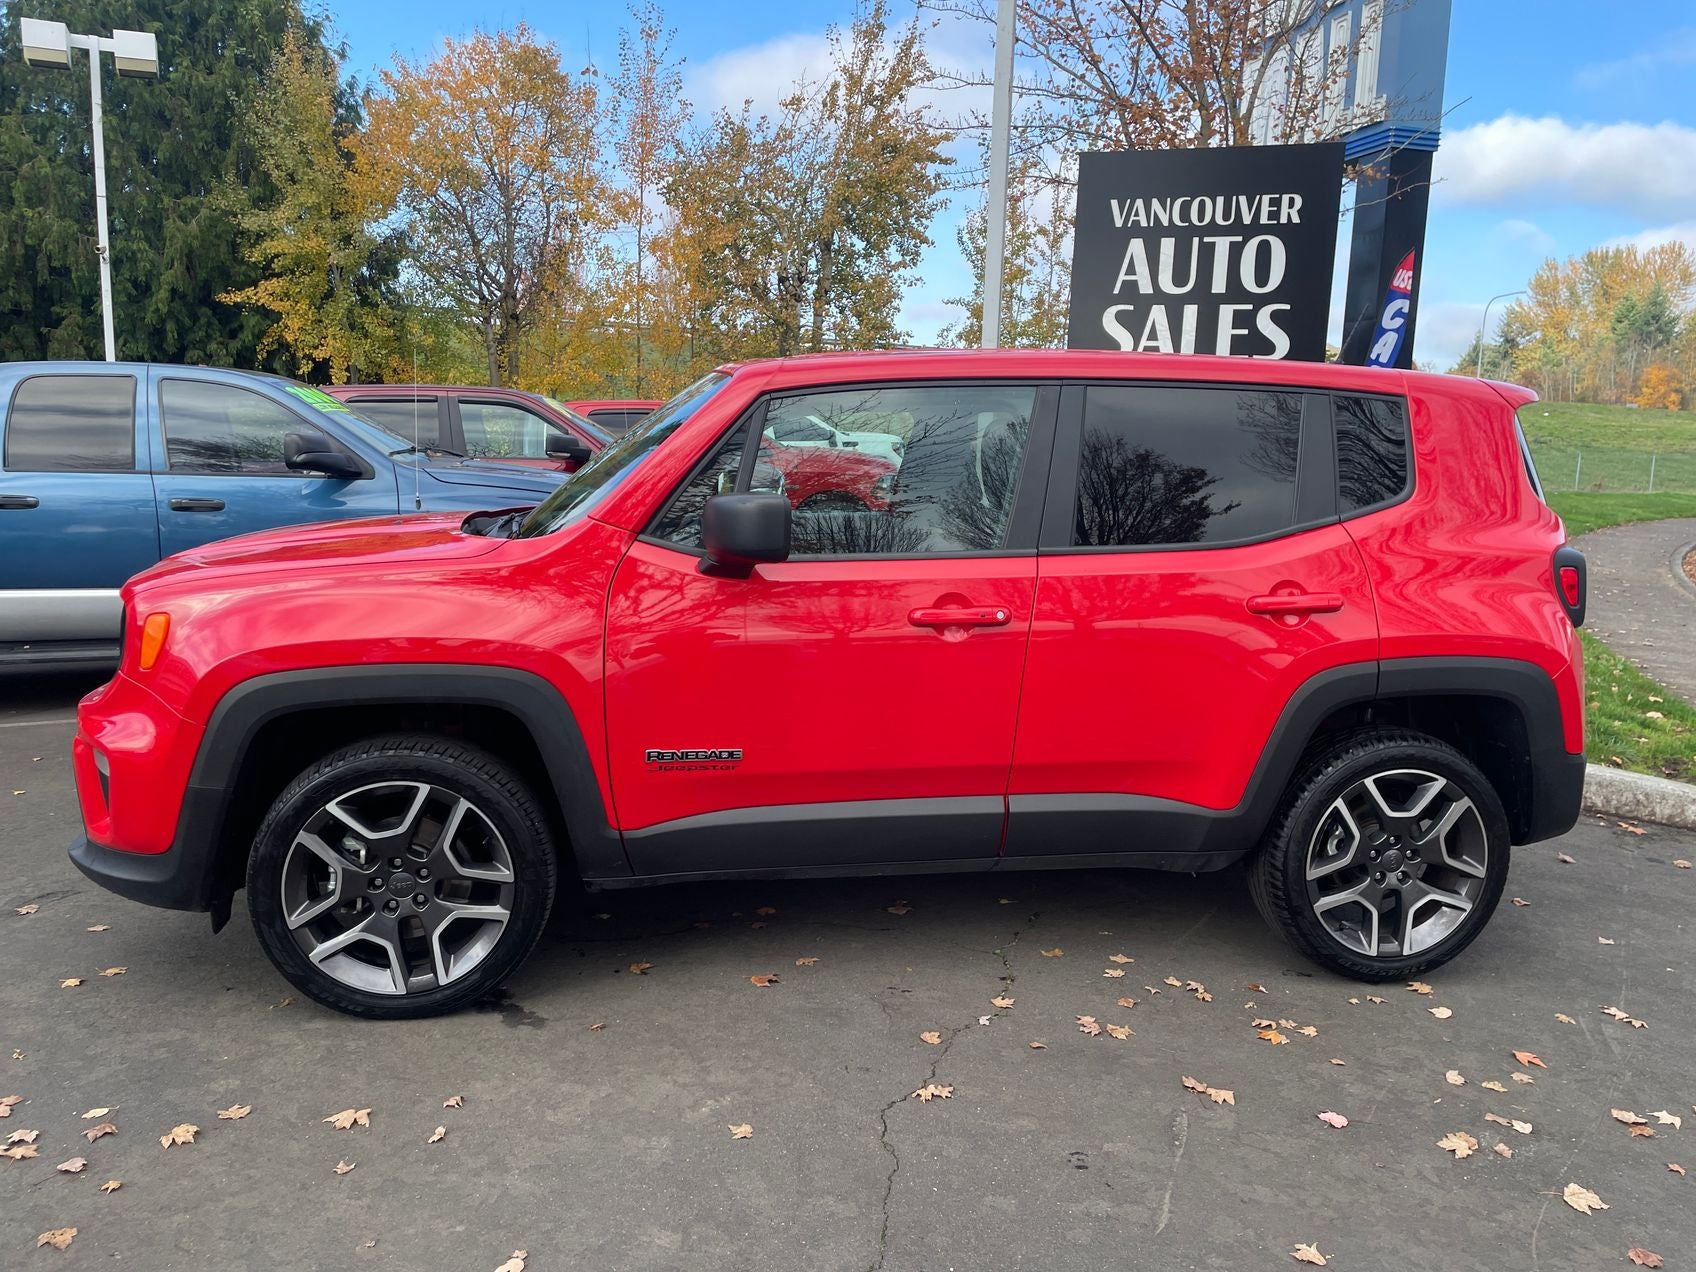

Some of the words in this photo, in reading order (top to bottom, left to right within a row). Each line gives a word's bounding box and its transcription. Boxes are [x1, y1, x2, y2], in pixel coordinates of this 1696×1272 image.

[1110, 193, 1303, 228] VANCOUVER
[1113, 234, 1287, 295] AUTO
[1102, 303, 1291, 359] SALES
[645, 748, 743, 762] RENEGADE
